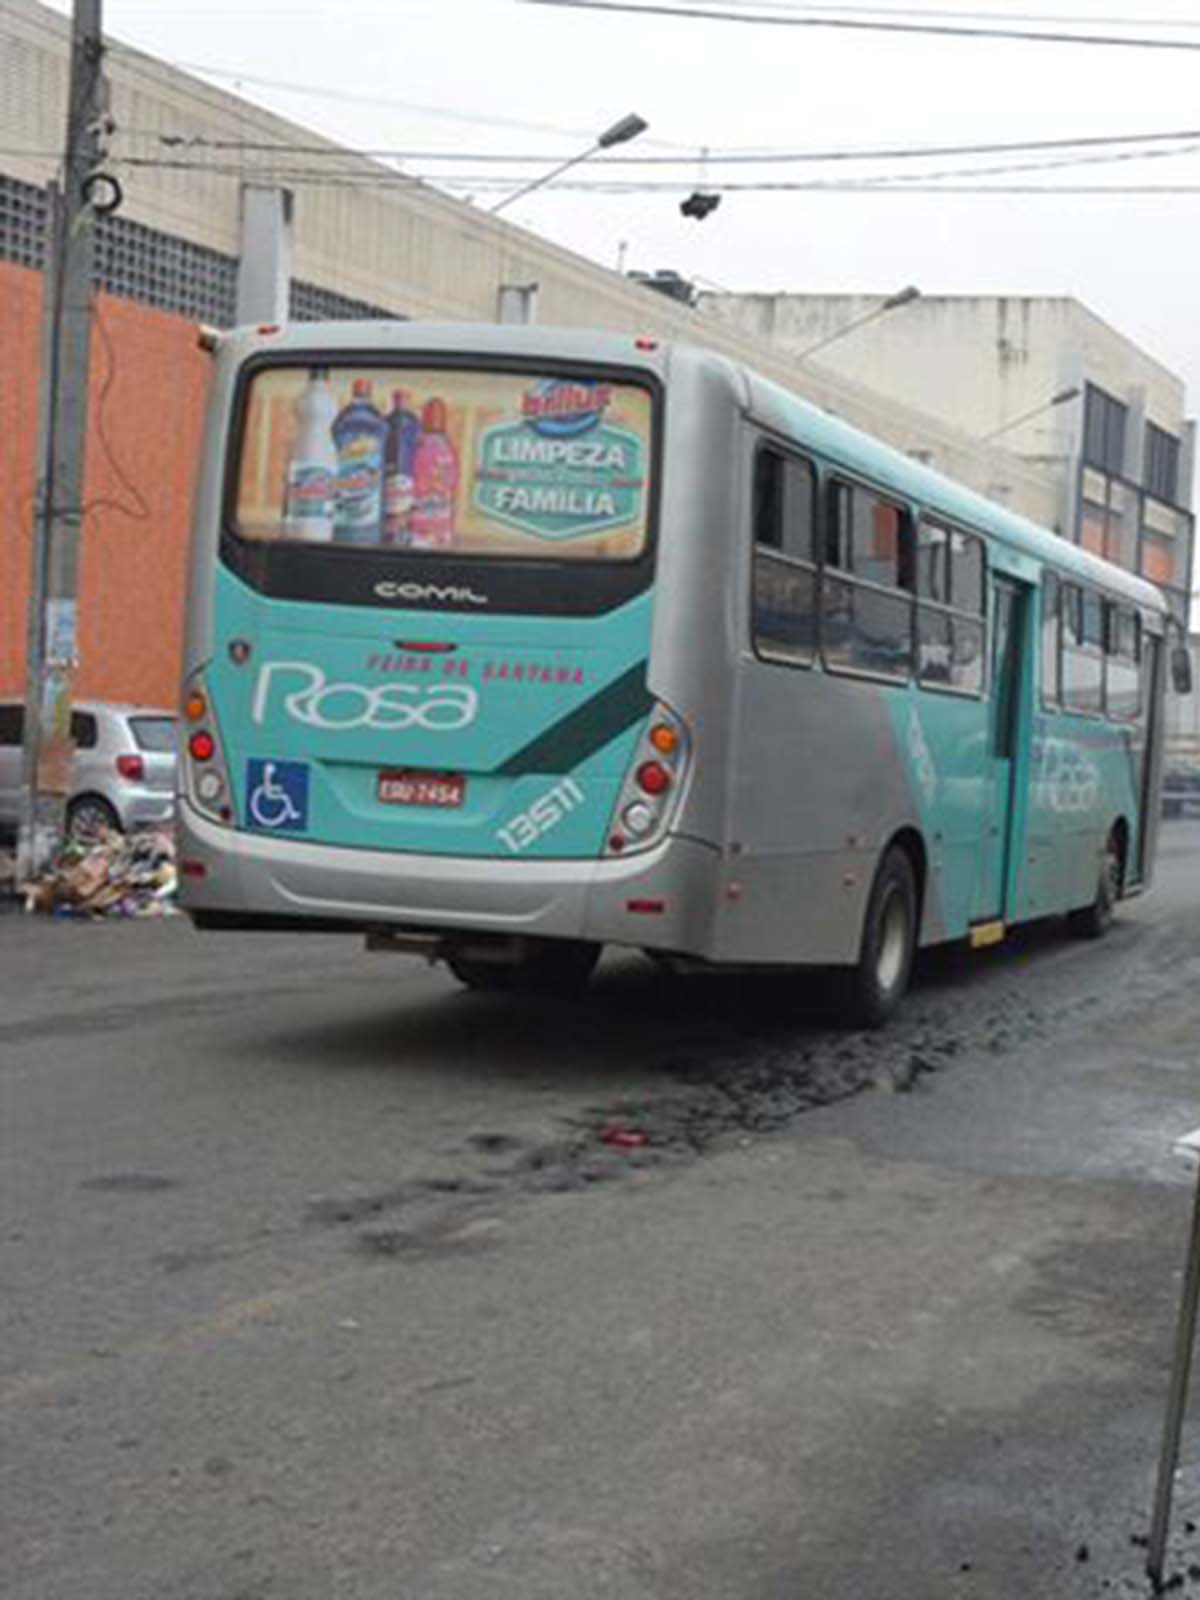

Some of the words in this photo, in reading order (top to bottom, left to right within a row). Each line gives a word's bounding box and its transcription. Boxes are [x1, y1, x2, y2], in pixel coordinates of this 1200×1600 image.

[493, 438, 625, 470] LIMPEZA
[374, 581, 488, 604] COMIL
[252, 661, 478, 731] Rosa
[498, 778, 585, 853] 13511
